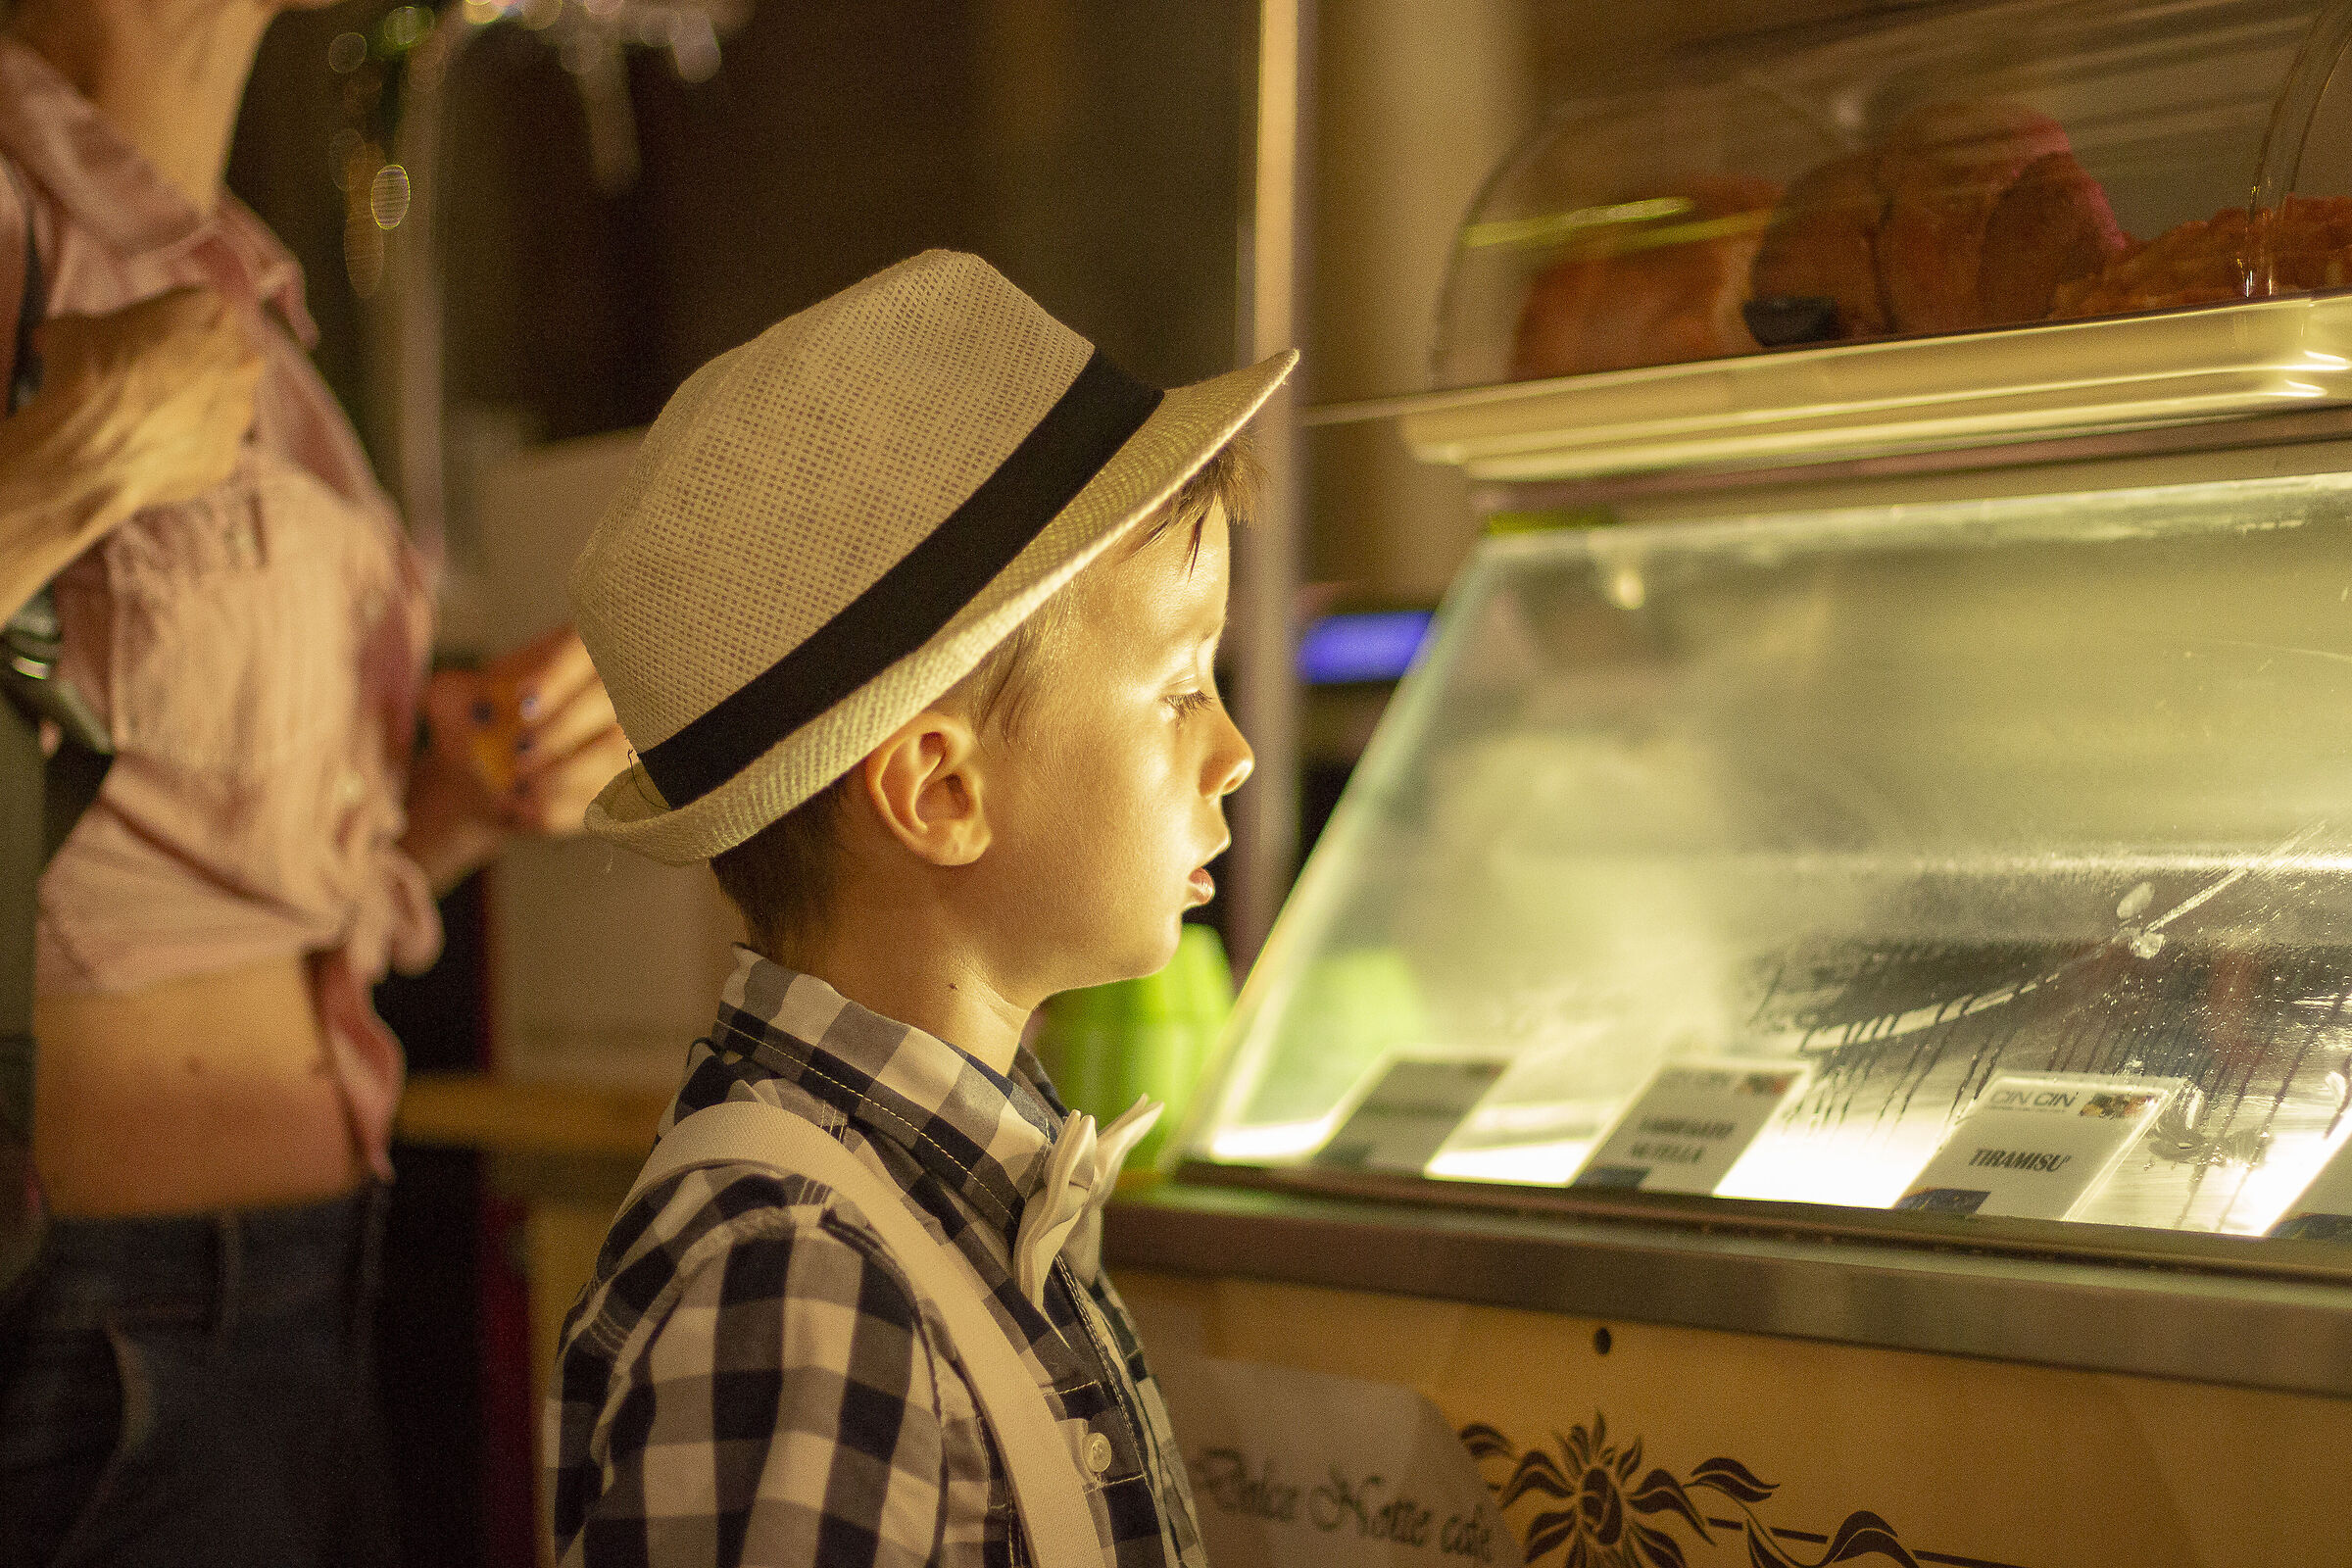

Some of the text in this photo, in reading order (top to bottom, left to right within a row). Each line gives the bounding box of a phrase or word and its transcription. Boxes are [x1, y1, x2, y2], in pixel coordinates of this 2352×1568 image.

[1990, 1090, 2076, 1108] CIN CIN
[1307, 1462, 1432, 1548] Notte
